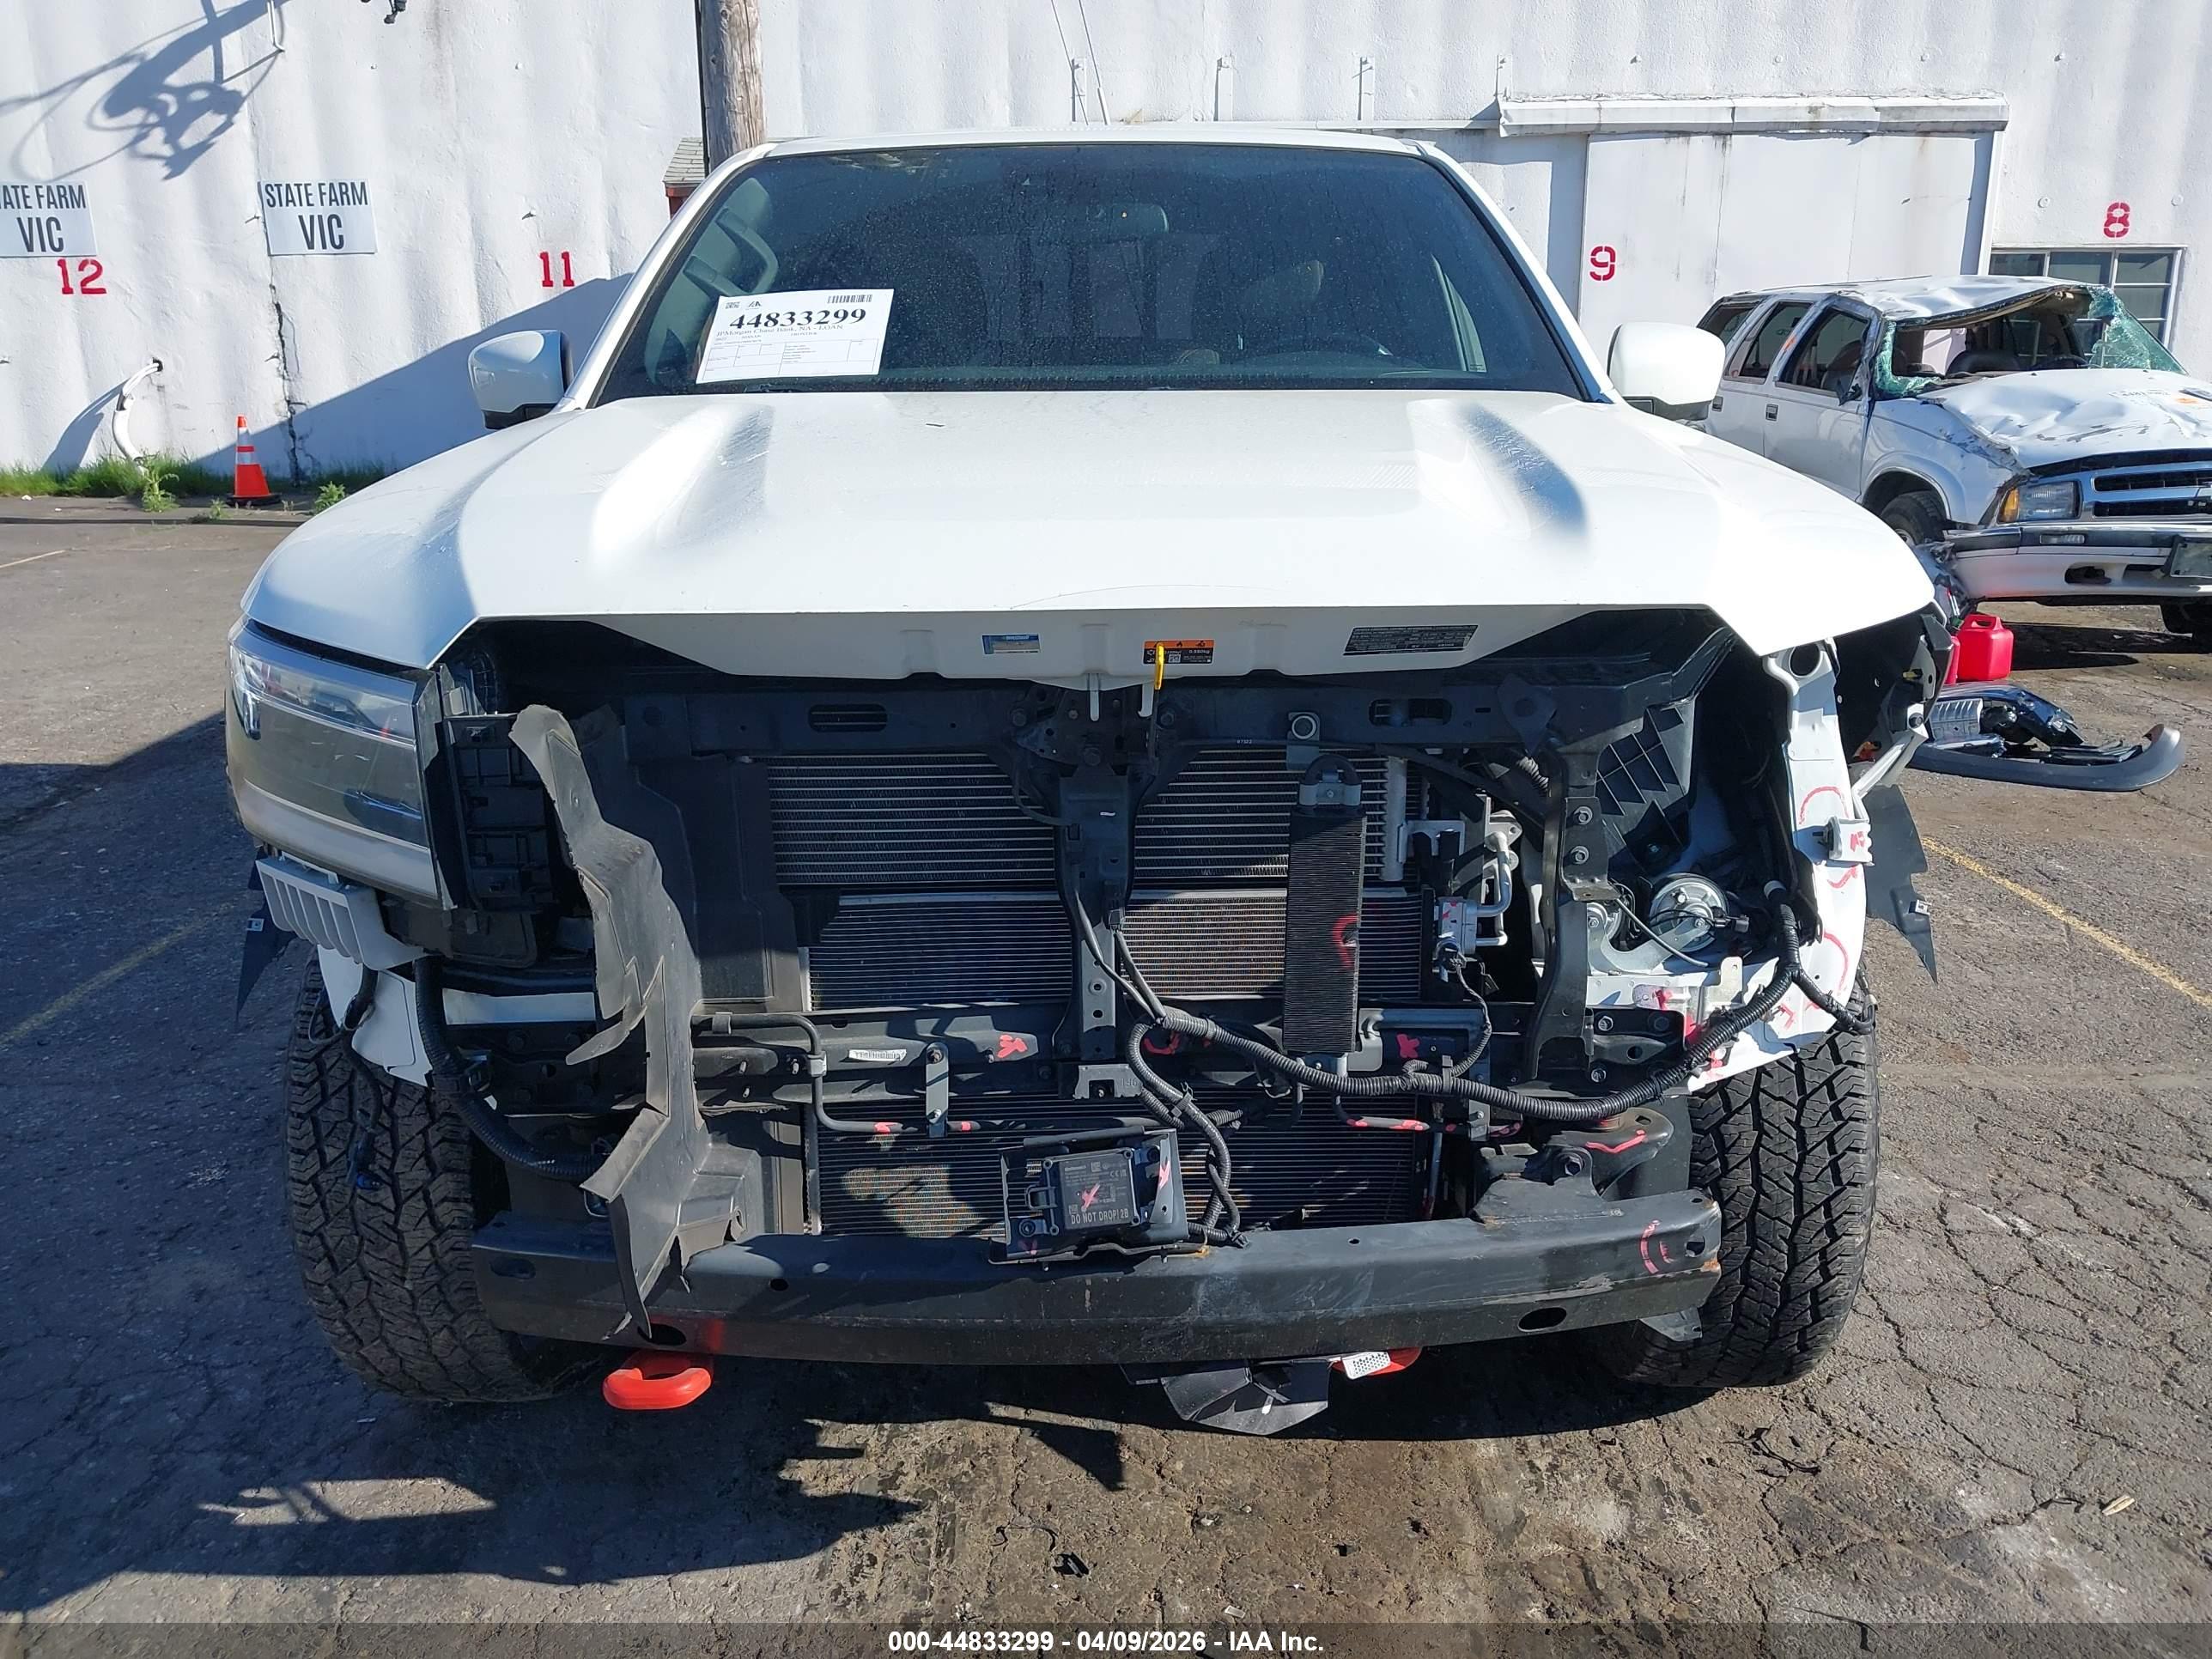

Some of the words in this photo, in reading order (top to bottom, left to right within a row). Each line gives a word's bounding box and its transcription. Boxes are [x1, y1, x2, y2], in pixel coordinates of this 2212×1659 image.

[0, 185, 33, 210] ATE
[34, 184, 87, 210] FARM
[264, 183, 315, 208] STATE
[318, 181, 368, 207] FARM
[16, 216, 64, 253] VIC
[297, 214, 344, 251] VIC
[2104, 202, 2130, 238] 8
[57, 258, 107, 295] 12
[539, 251, 575, 288] 11
[1589, 246, 1616, 282] 9
[729, 308, 866, 330] 44833299
[1071, 1214, 1081, 1224] DO
[1082, 1212, 1097, 1224] NOT
[1098, 1210, 1120, 1222] DROP!
